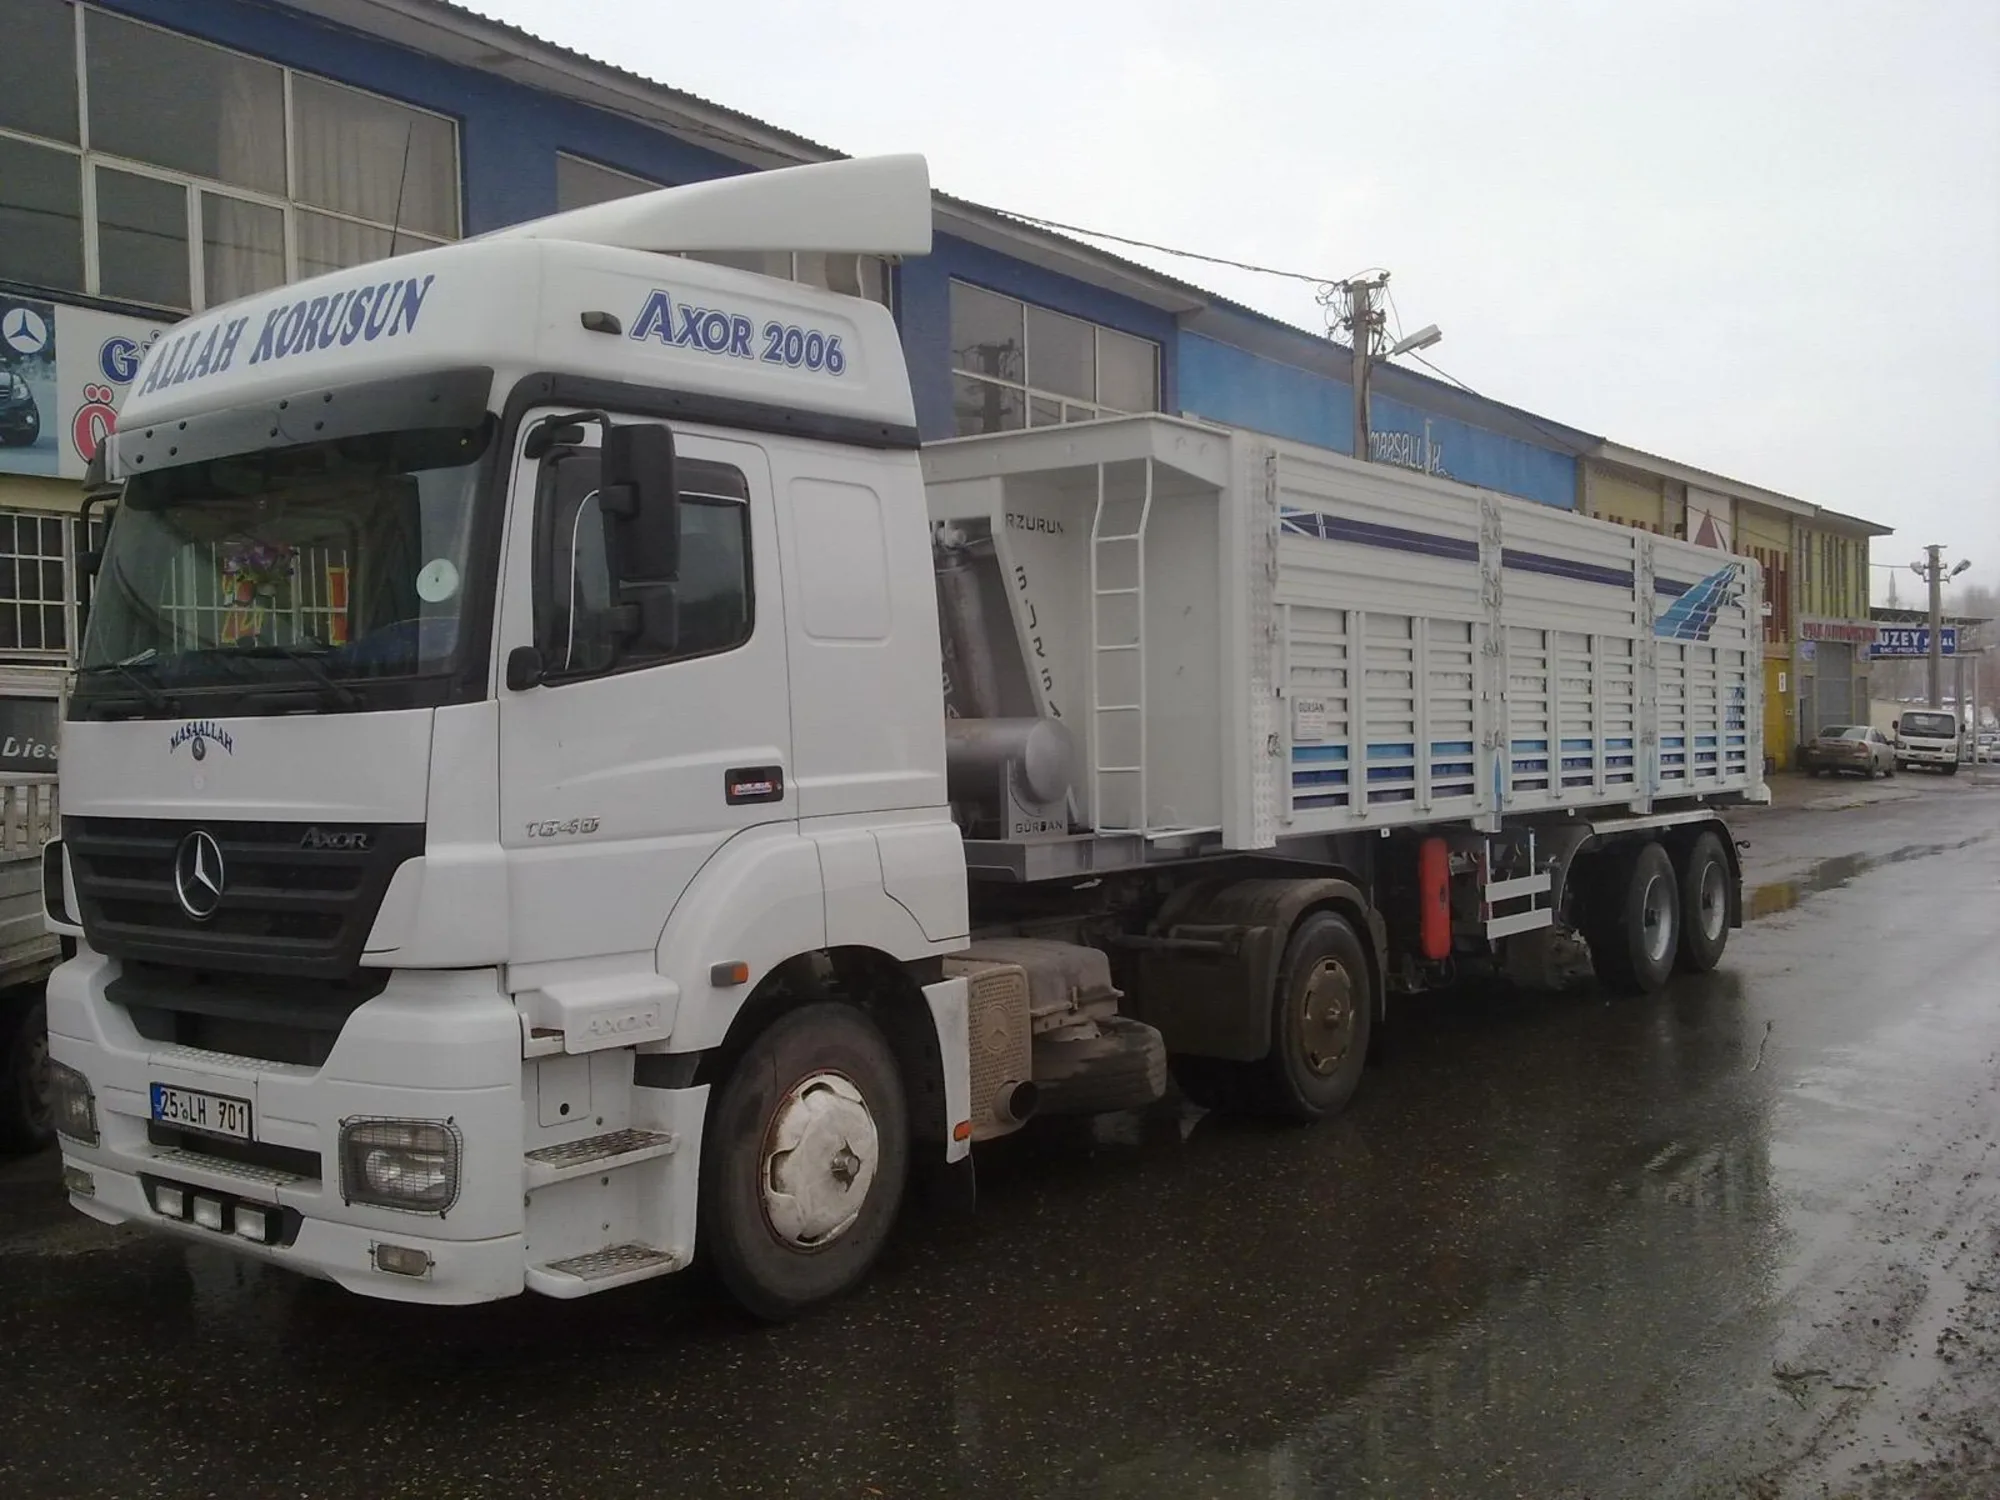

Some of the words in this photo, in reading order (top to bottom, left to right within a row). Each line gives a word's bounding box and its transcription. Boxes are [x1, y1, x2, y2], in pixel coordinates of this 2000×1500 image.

[139, 316, 249, 397] ALLAH
[249, 275, 435, 365] KORUSUN
[760, 321, 846, 377] 2006
[1871, 630, 1921, 646] UZEY
[161, 1090, 178, 1118] 25
[189, 1095, 206, 1125] LH
[218, 1101, 245, 1133] 701
